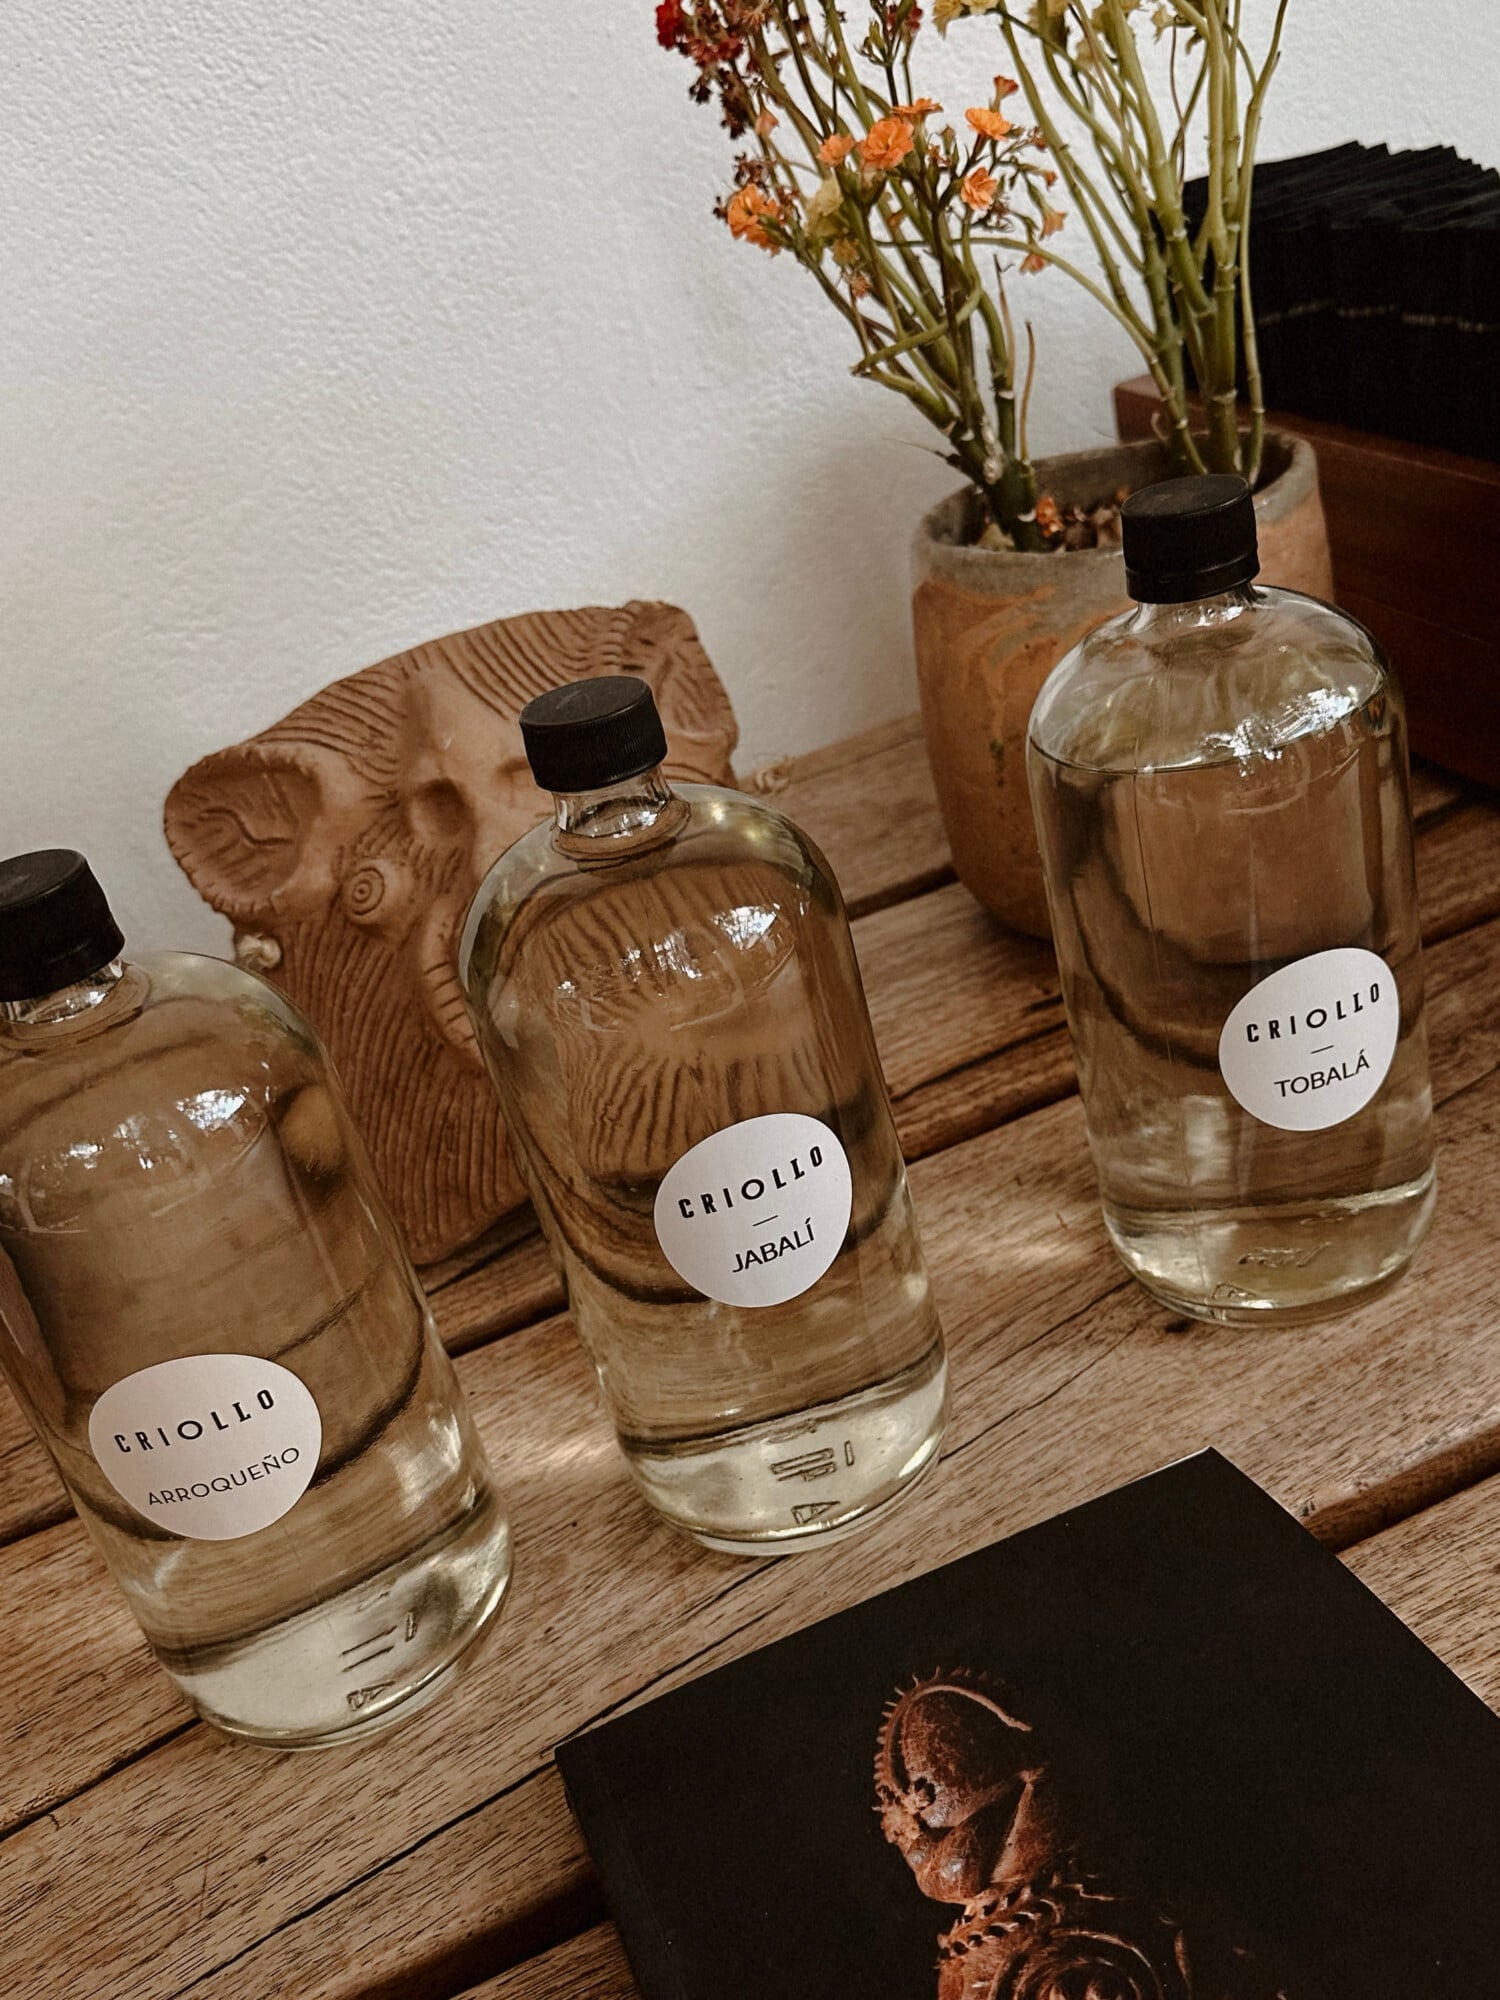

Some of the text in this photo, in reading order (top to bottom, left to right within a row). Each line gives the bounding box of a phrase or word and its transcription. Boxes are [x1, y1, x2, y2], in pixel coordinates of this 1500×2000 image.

[1246, 982, 1380, 1043] CRIOLLO
[1273, 1048, 1370, 1098] TOBALÁ
[677, 1145, 823, 1219] CRIOLLO
[732, 1217, 815, 1273] JABALÍ
[113, 1389, 274, 1454] CRIOLLO
[148, 1447, 300, 1506] ARROQUEÑO
